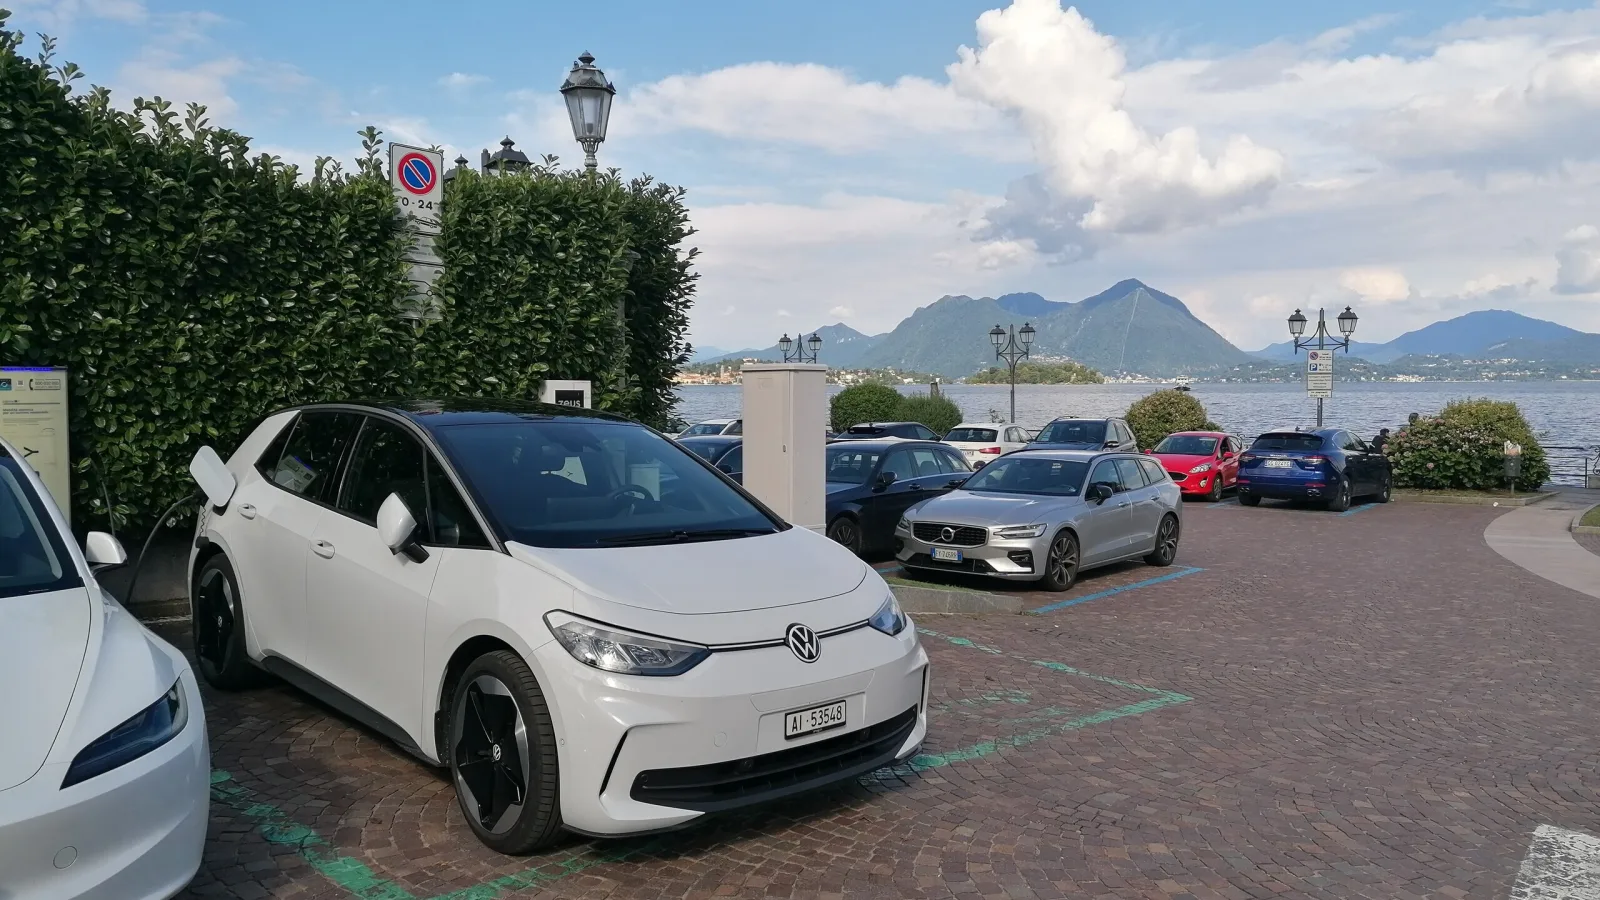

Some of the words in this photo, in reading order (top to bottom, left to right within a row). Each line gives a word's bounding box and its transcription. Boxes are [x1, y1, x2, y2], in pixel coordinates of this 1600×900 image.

[418, 199, 433, 211] 24
[791, 715, 802, 732] AI
[811, 705, 843, 727] 53548
